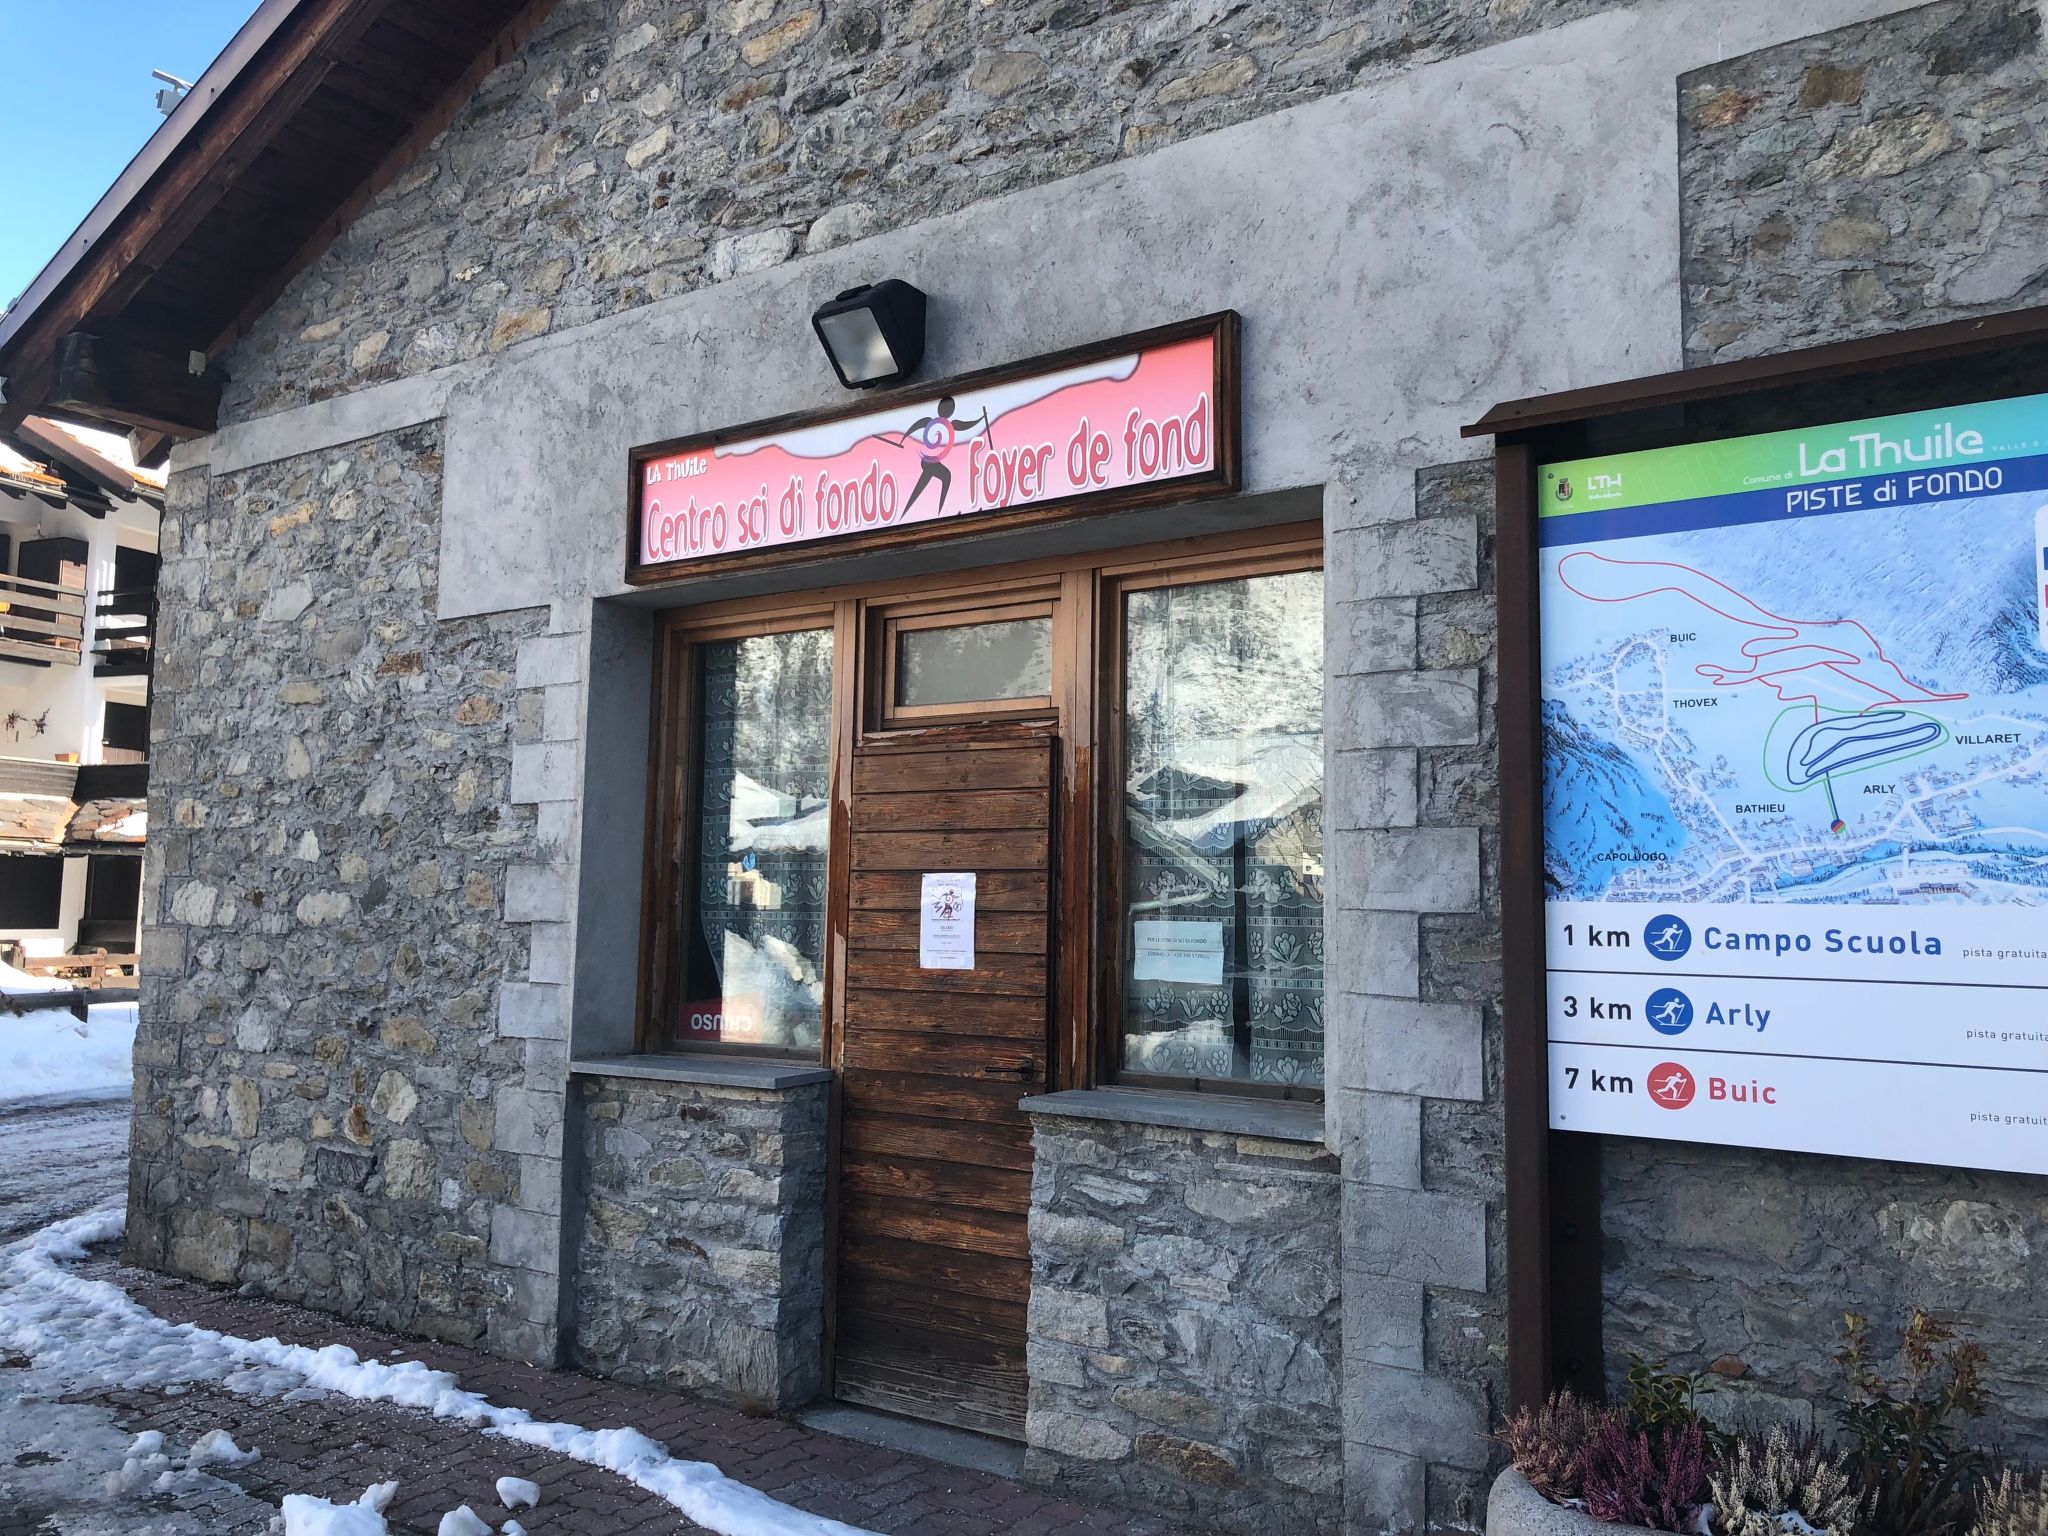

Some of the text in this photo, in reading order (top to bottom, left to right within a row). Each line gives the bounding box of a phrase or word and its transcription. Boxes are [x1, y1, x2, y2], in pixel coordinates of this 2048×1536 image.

[647, 465, 662, 486] LA
[647, 392, 1208, 561] Centro sci di fondo Foyer de fond
[1786, 466, 2003, 513] PISTE di FONDO
[1670, 632, 1697, 643] BUIC
[1673, 698, 1718, 709] THOVEX
[1955, 733, 2021, 745] VILLARET
[1863, 784, 1896, 794] ARLY
[1735, 803, 1785, 814] BATHIEU
[1597, 852, 1666, 862] CAPOLUOGO
[1563, 924, 2047, 960] 1 km Campo Scuola pista gratuita
[1563, 995, 1578, 1018] 3
[1590, 997, 1632, 1020] km
[1705, 1002, 1771, 1033] Arly
[1966, 1029, 1996, 1040] pista
[1564, 1067, 2048, 1126] 7 km Buic pista gratuit
